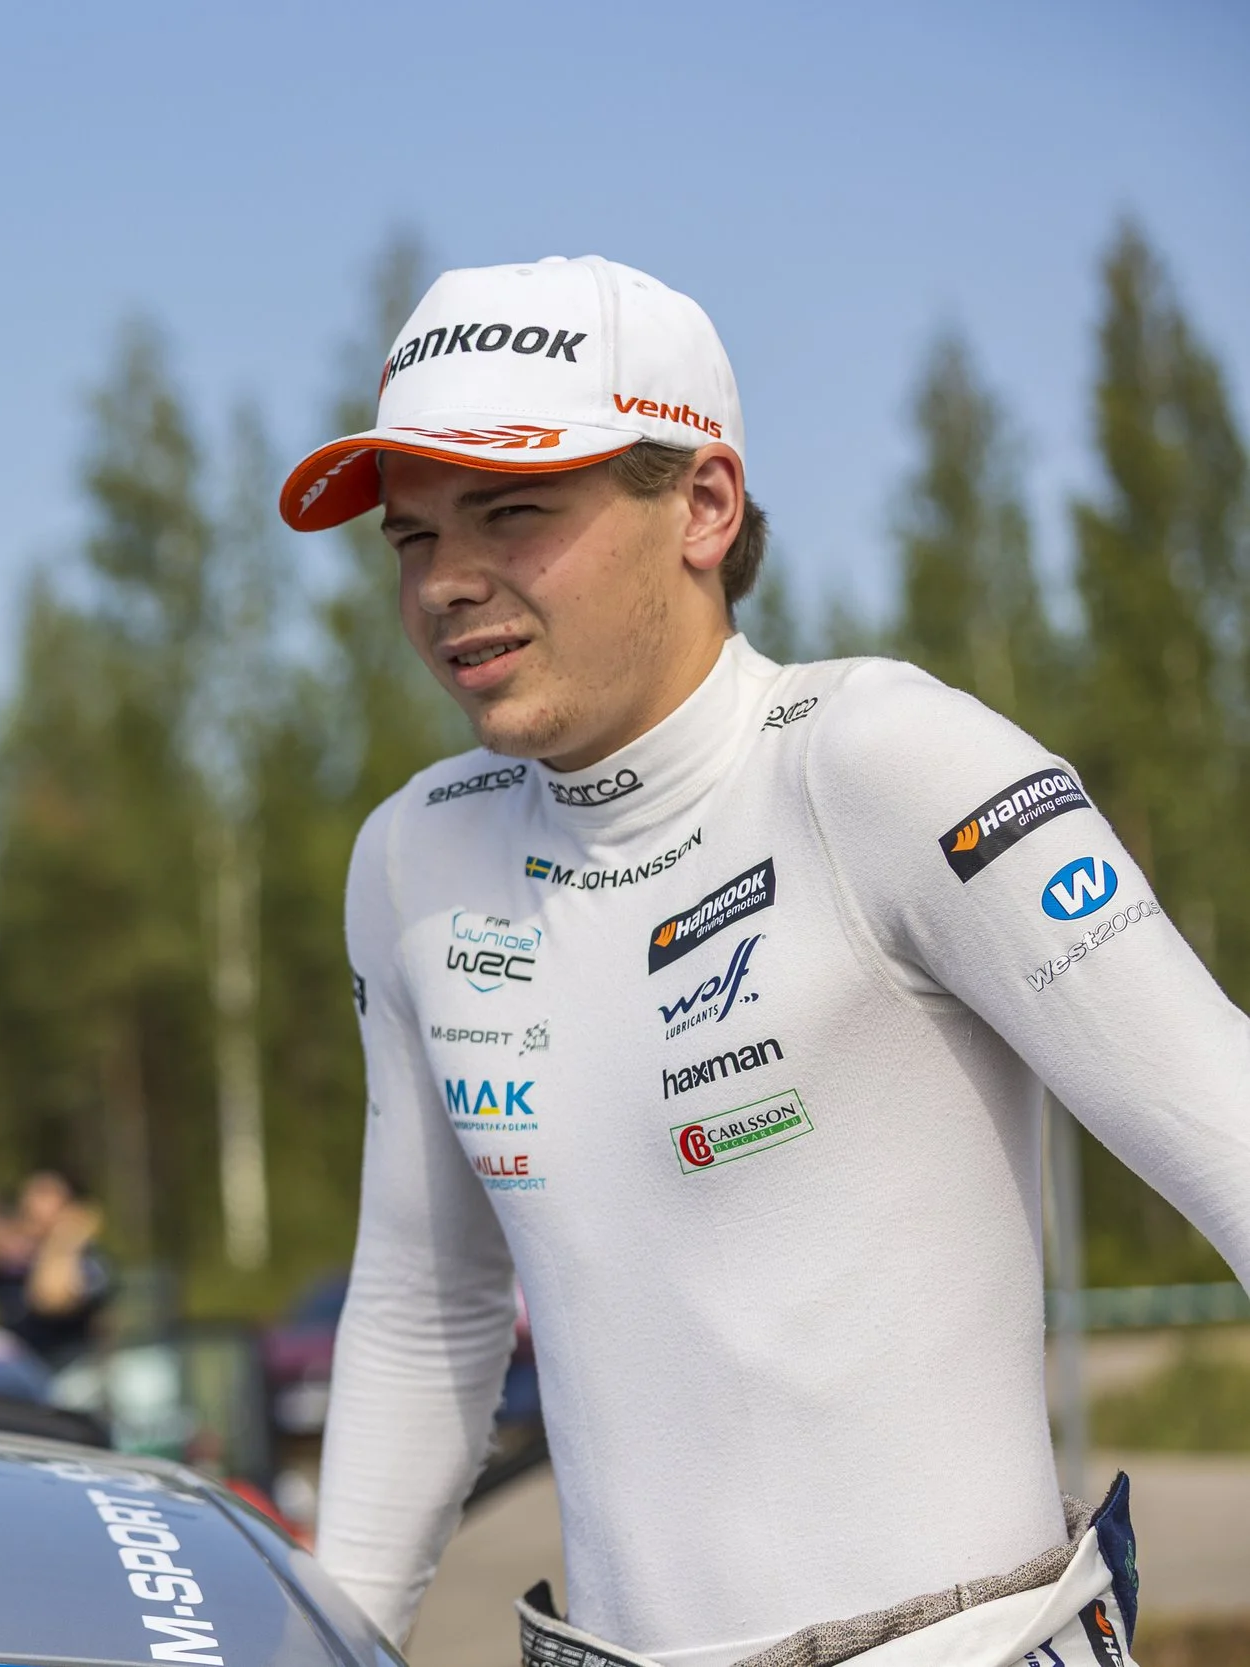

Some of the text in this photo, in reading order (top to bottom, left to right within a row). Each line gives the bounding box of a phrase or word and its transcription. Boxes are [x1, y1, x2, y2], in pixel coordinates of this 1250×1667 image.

[978, 775, 1077, 837] HANKOOK
[1018, 799, 1056, 827] driving
[551, 827, 703, 890] M.JOHANSSON
[485, 916, 510, 928] FIA
[675, 869, 767, 941] HANKOOK
[696, 891, 766, 939] driving emotion
[456, 928, 534, 951] JUNIOR
[447, 945, 536, 982] WRC
[431, 1025, 514, 1046] M-SPORT
[665, 1004, 719, 1041] LUBRICANTS
[662, 1038, 784, 1100] haxman
[445, 1079, 535, 1116] MAK
[707, 1103, 797, 1143] CARLSSON
[715, 1118, 799, 1152] BYGGARE AB
[86, 1489, 225, 1667] M-SPORT
